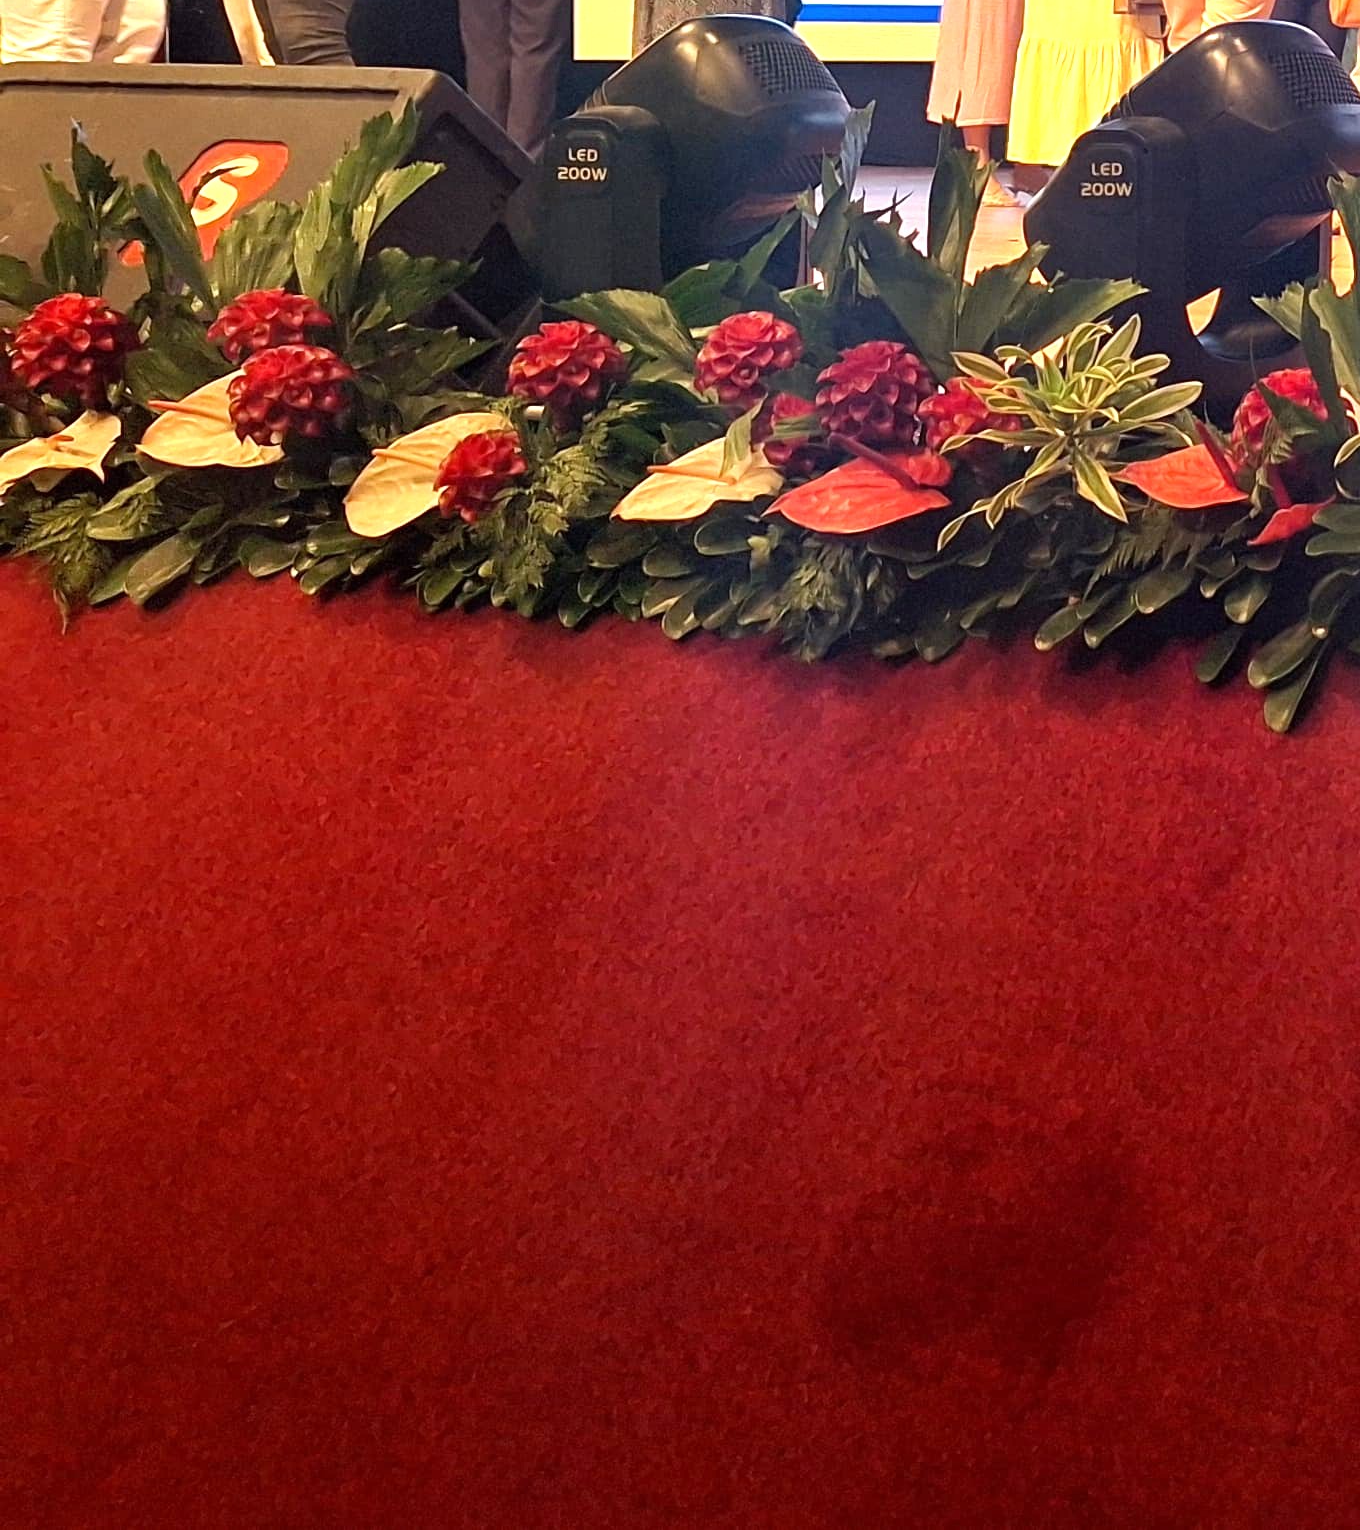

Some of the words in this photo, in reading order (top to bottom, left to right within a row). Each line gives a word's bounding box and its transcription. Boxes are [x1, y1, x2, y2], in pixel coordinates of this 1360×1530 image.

[568, 146, 599, 162] LED
[557, 166, 608, 181] 200W
[1091, 161, 1124, 176] LED
[1080, 182, 1133, 197] 200W
